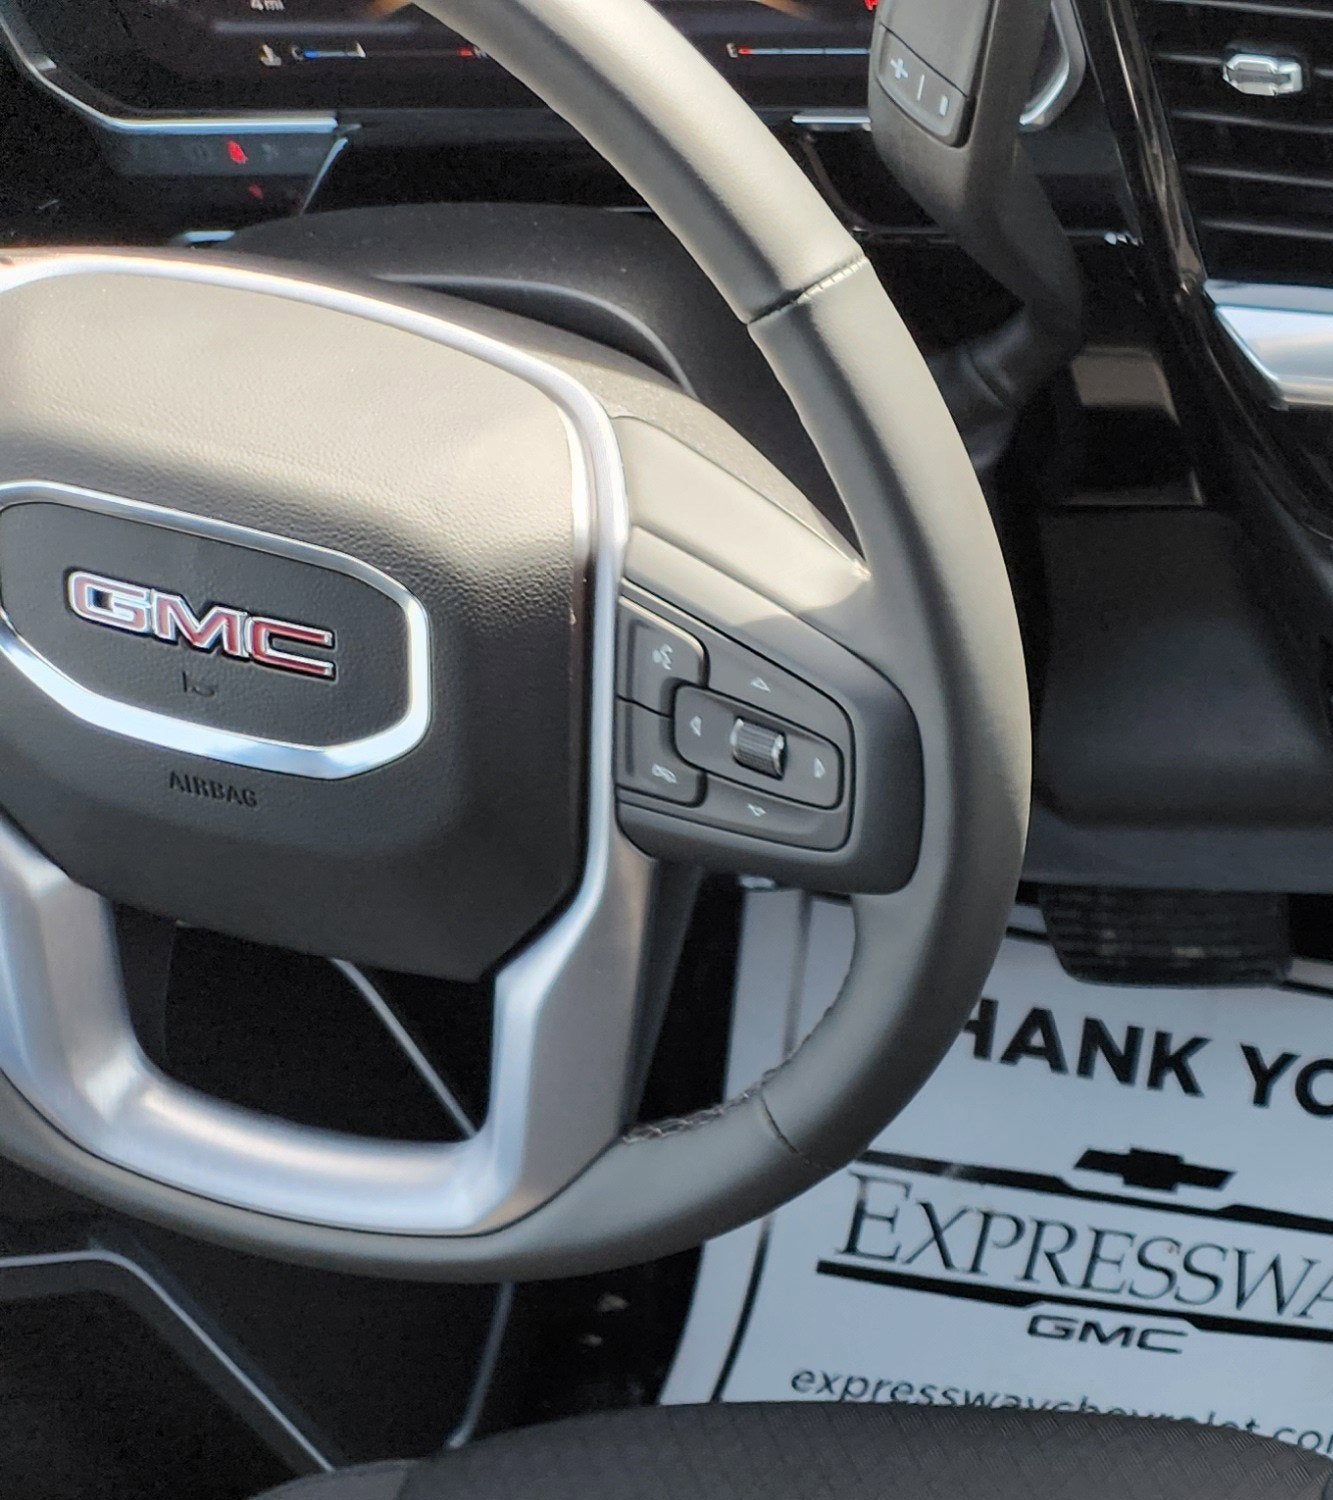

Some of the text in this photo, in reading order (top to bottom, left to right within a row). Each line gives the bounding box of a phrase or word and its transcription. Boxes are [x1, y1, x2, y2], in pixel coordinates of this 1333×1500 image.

[67, 570, 338, 680] GMC
[168, 770, 259, 808] AIRBAG
[964, 998, 1214, 1099] HANK
[1027, 1313, 1189, 1354] GMC
